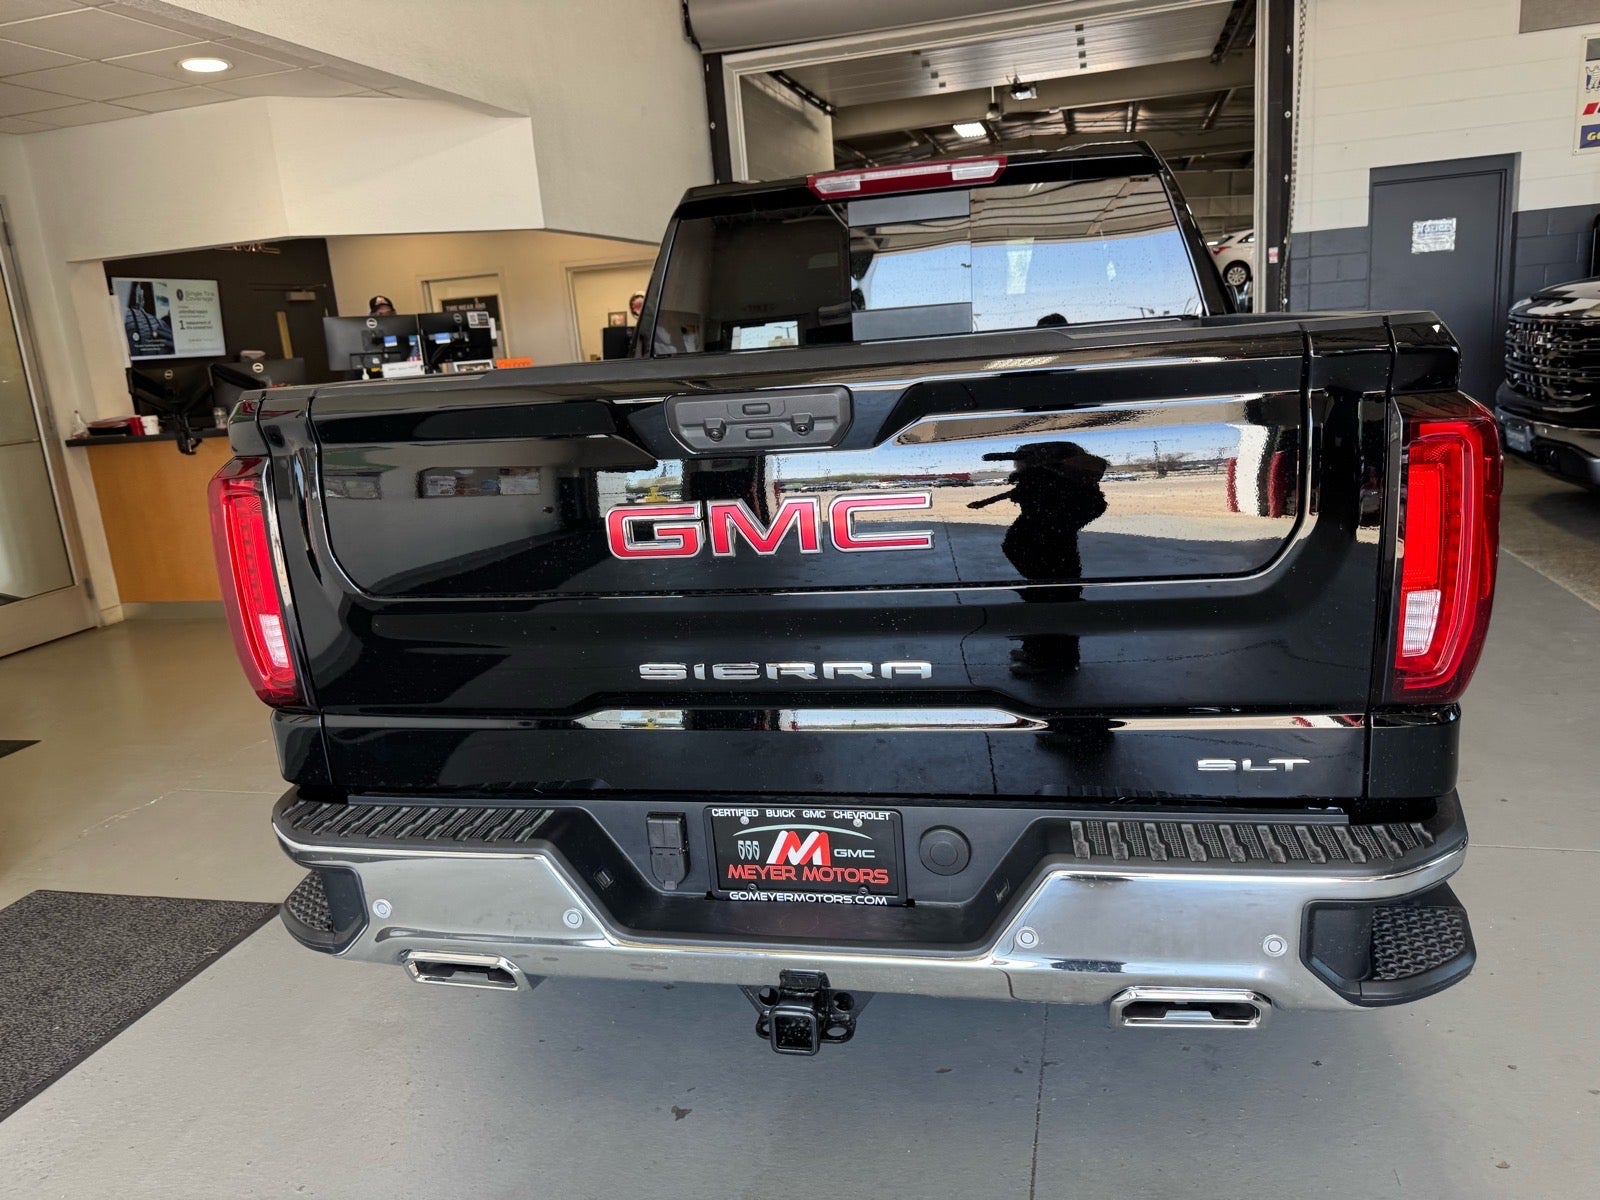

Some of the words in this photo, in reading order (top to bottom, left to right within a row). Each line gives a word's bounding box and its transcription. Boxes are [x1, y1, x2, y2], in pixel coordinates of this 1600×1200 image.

[605, 491, 935, 560] GMC
[638, 661, 933, 680] SIERRA
[1197, 758, 1311, 772] SLT
[711, 808, 759, 818] CERTIFIED
[765, 809, 796, 818] BUICK
[802, 810, 827, 819] GMC
[833, 811, 891, 821] CHEVROLET
[833, 848, 876, 859] GMC
[727, 864, 797, 881] MEYER
[802, 866, 889, 884] MOTORS
[729, 891, 888, 905] GOMEYERMOTORS.COM
